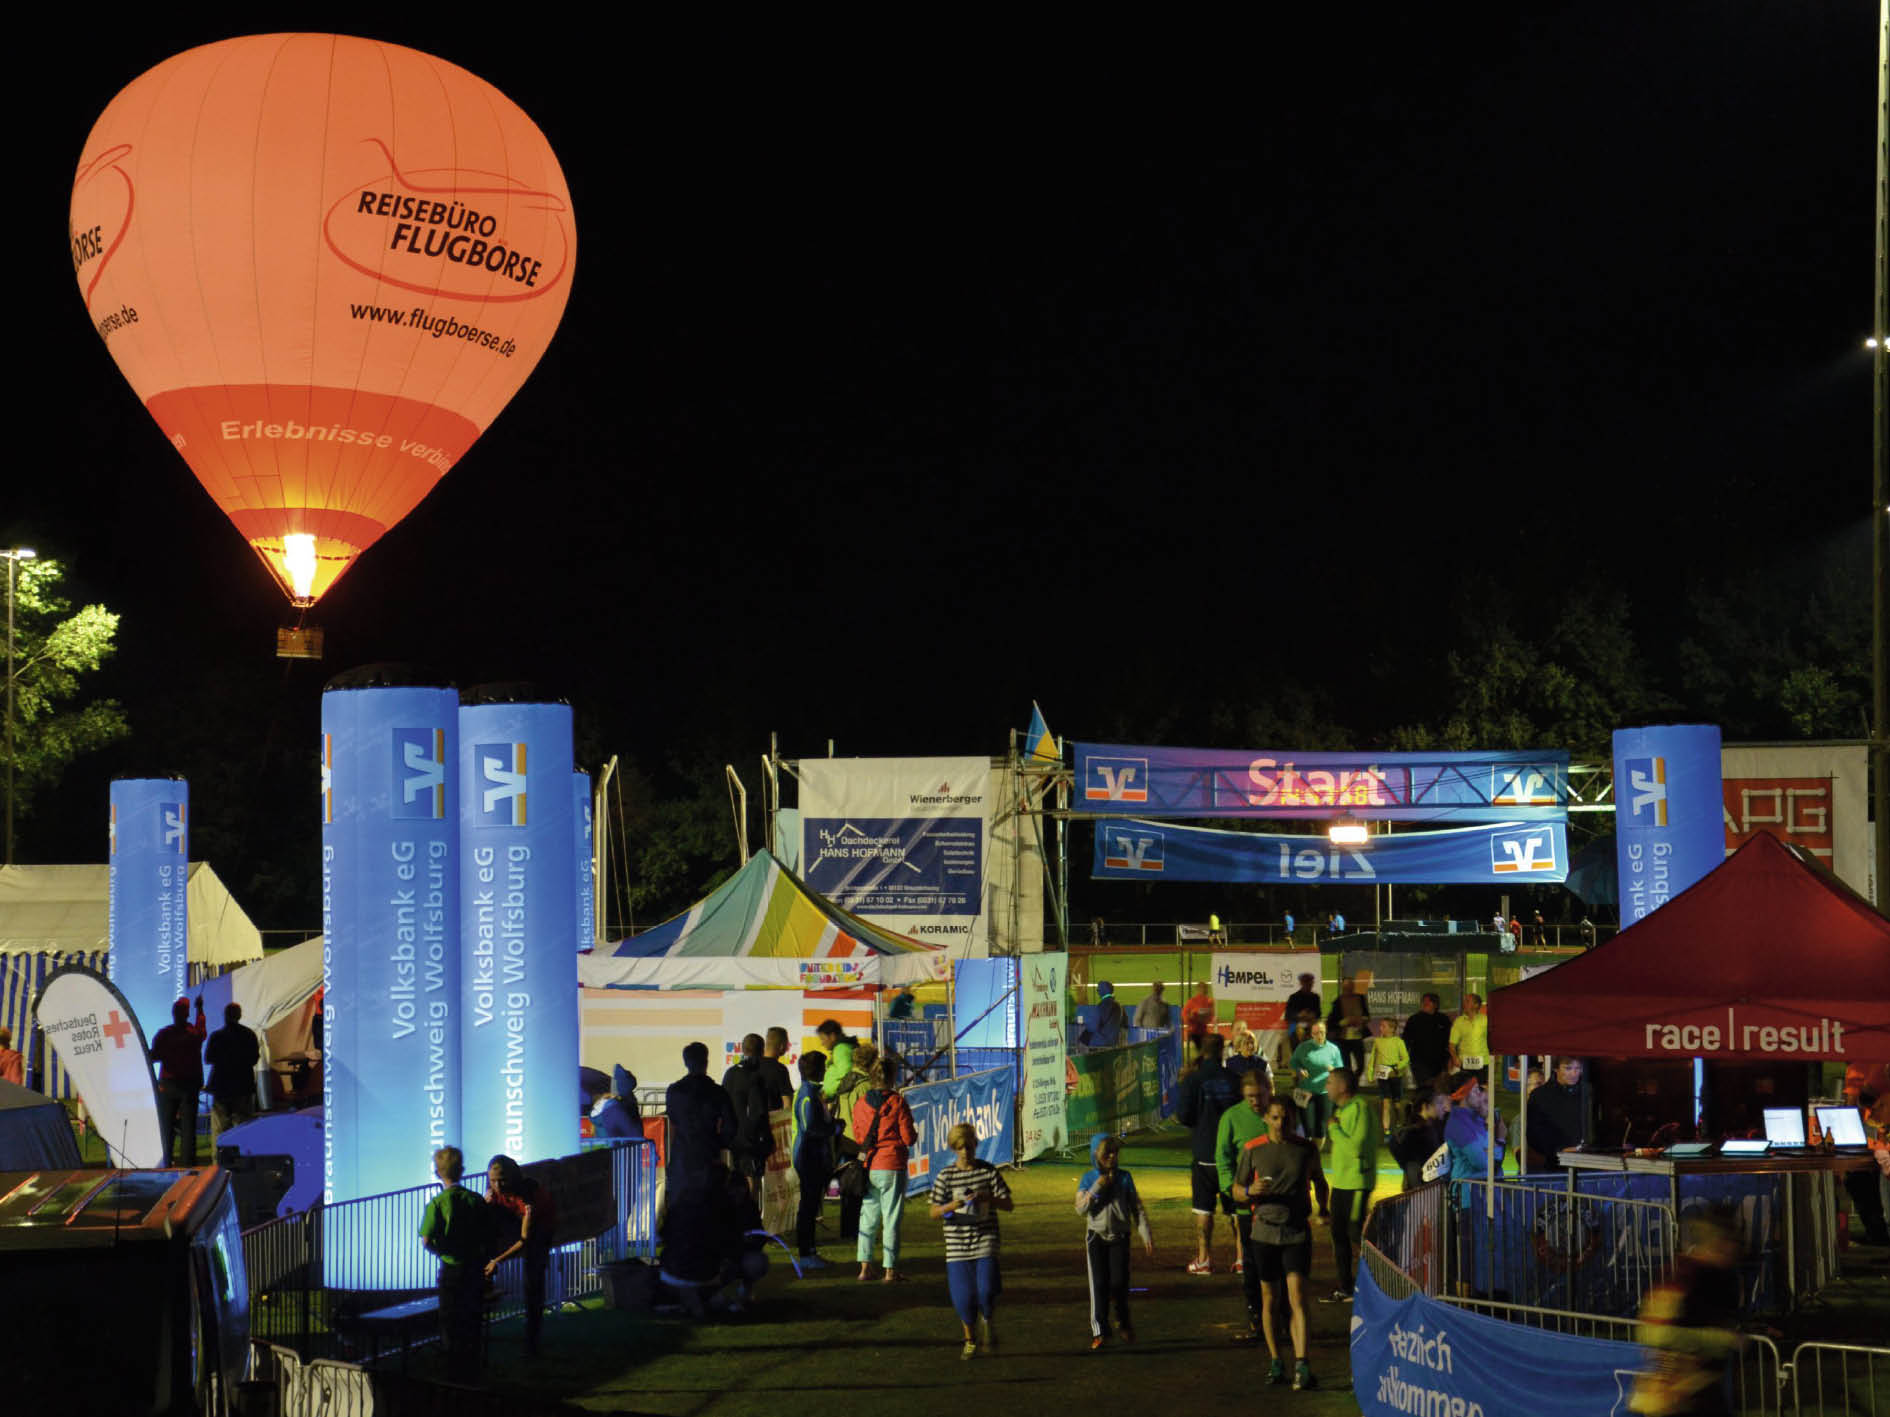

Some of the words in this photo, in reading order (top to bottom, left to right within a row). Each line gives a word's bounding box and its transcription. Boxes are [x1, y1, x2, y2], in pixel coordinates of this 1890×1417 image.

[357, 191, 497, 238] REISEBÜRO
[390, 223, 542, 287] FLUGBÖRSE
[350, 303, 516, 358] www.flugboerse.de
[220, 419, 393, 448] Erlebnisse
[910, 794, 983, 805] Wienerberger
[1249, 758, 1387, 806] Start
[391, 841, 416, 881] eG
[474, 847, 495, 883] eG
[819, 847, 849, 858] HANS
[851, 847, 906, 858] HOFMANN
[1628, 843, 1643, 873] eG
[159, 864, 173, 888] eG
[423, 839, 447, 993] Wolfsburg
[501, 845, 531, 985] Wolfsburg
[580, 887, 591, 949] lksbank
[1628, 879, 1646, 919] ank
[157, 891, 173, 976] Volksbank
[920, 925, 969, 934] KORAMIC
[390, 889, 416, 1039] Volksbank
[473, 890, 495, 1027] Volksbank
[1645, 1023, 1721, 1051] race
[1743, 1018, 1846, 1054] result
